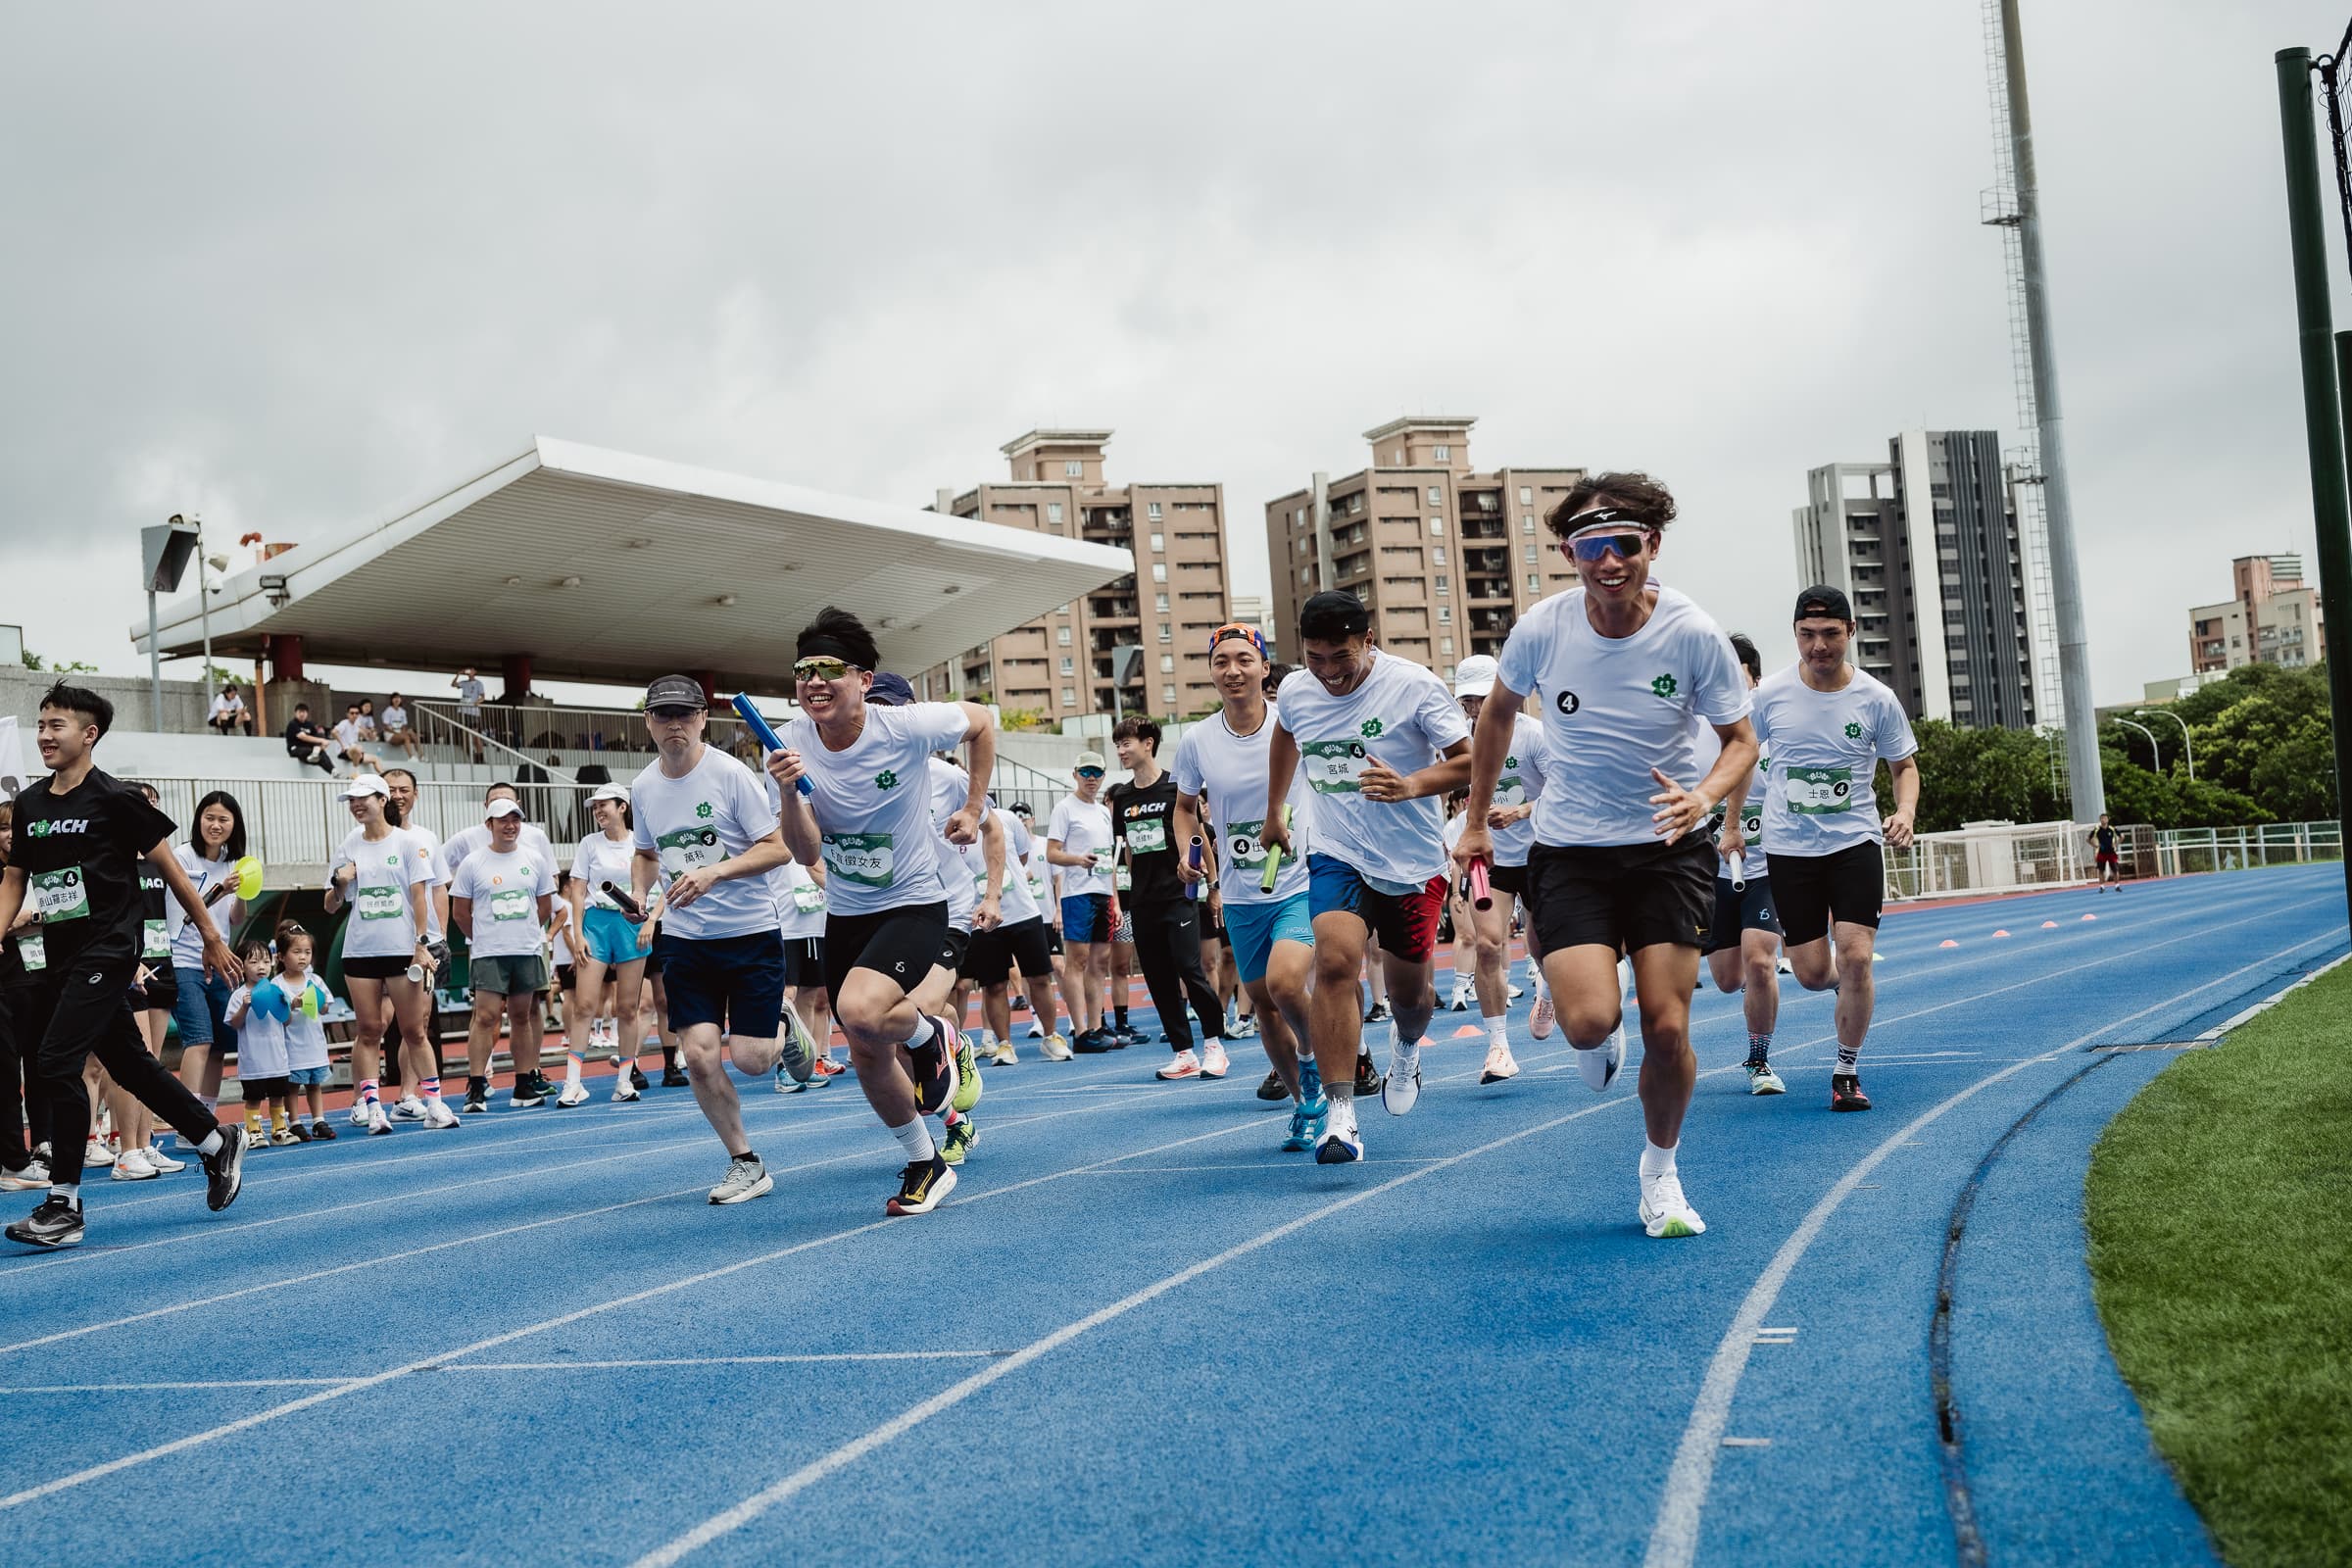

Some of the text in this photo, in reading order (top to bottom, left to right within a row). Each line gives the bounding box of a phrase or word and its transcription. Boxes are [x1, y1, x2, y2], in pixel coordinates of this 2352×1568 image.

[1560, 694, 1576, 711] 4
[1352, 745, 1363, 758] 4
[1836, 783, 1846, 796] 4
[1749, 818, 1760, 831] 4
[703, 833, 713, 846] 4
[1236, 840, 1248, 854] 4
[66, 872, 76, 885] 4
